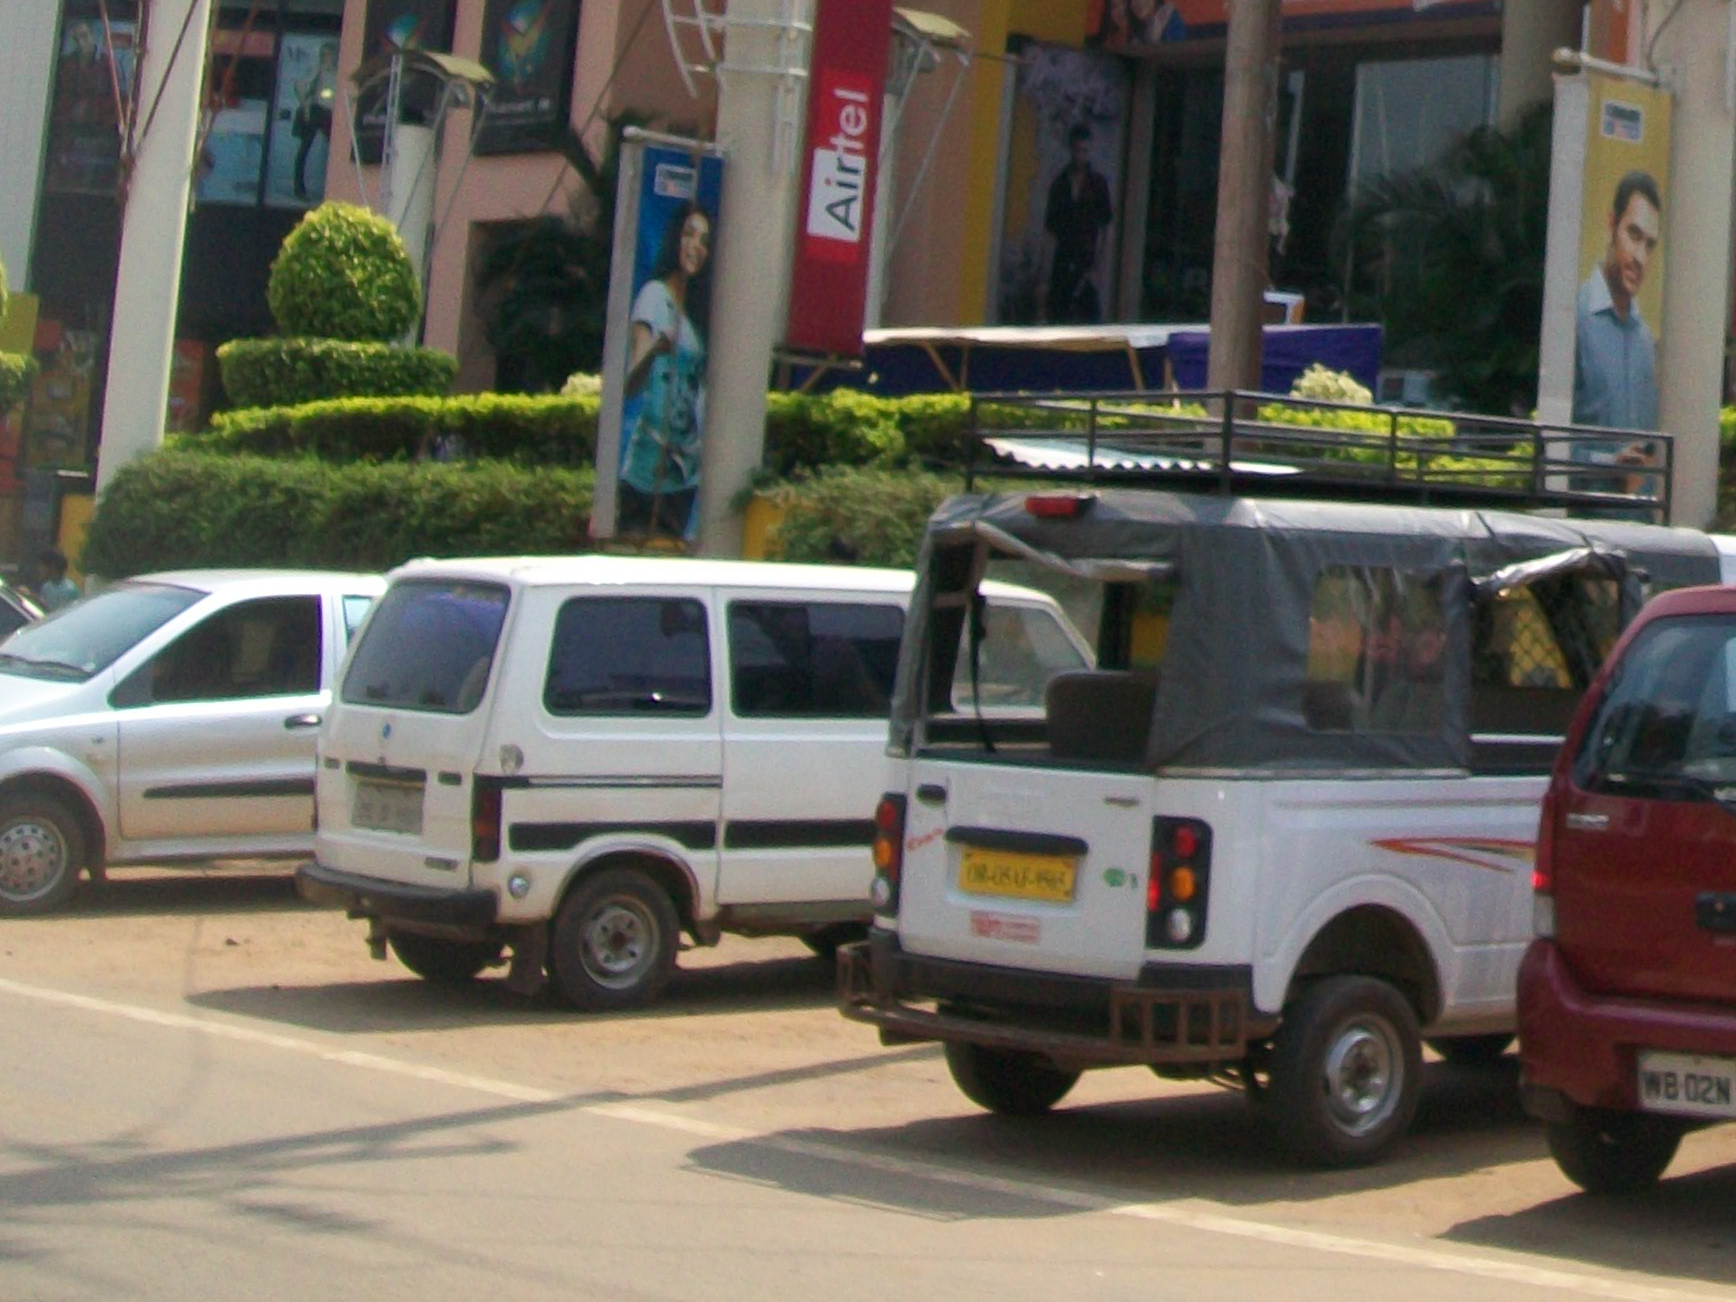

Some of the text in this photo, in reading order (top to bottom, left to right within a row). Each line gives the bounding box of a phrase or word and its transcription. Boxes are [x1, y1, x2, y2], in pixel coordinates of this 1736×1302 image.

[824, 87, 869, 232] Airtel
[1642, 1071, 1680, 1101] WB
[1683, 1072, 1731, 1106] 02N
